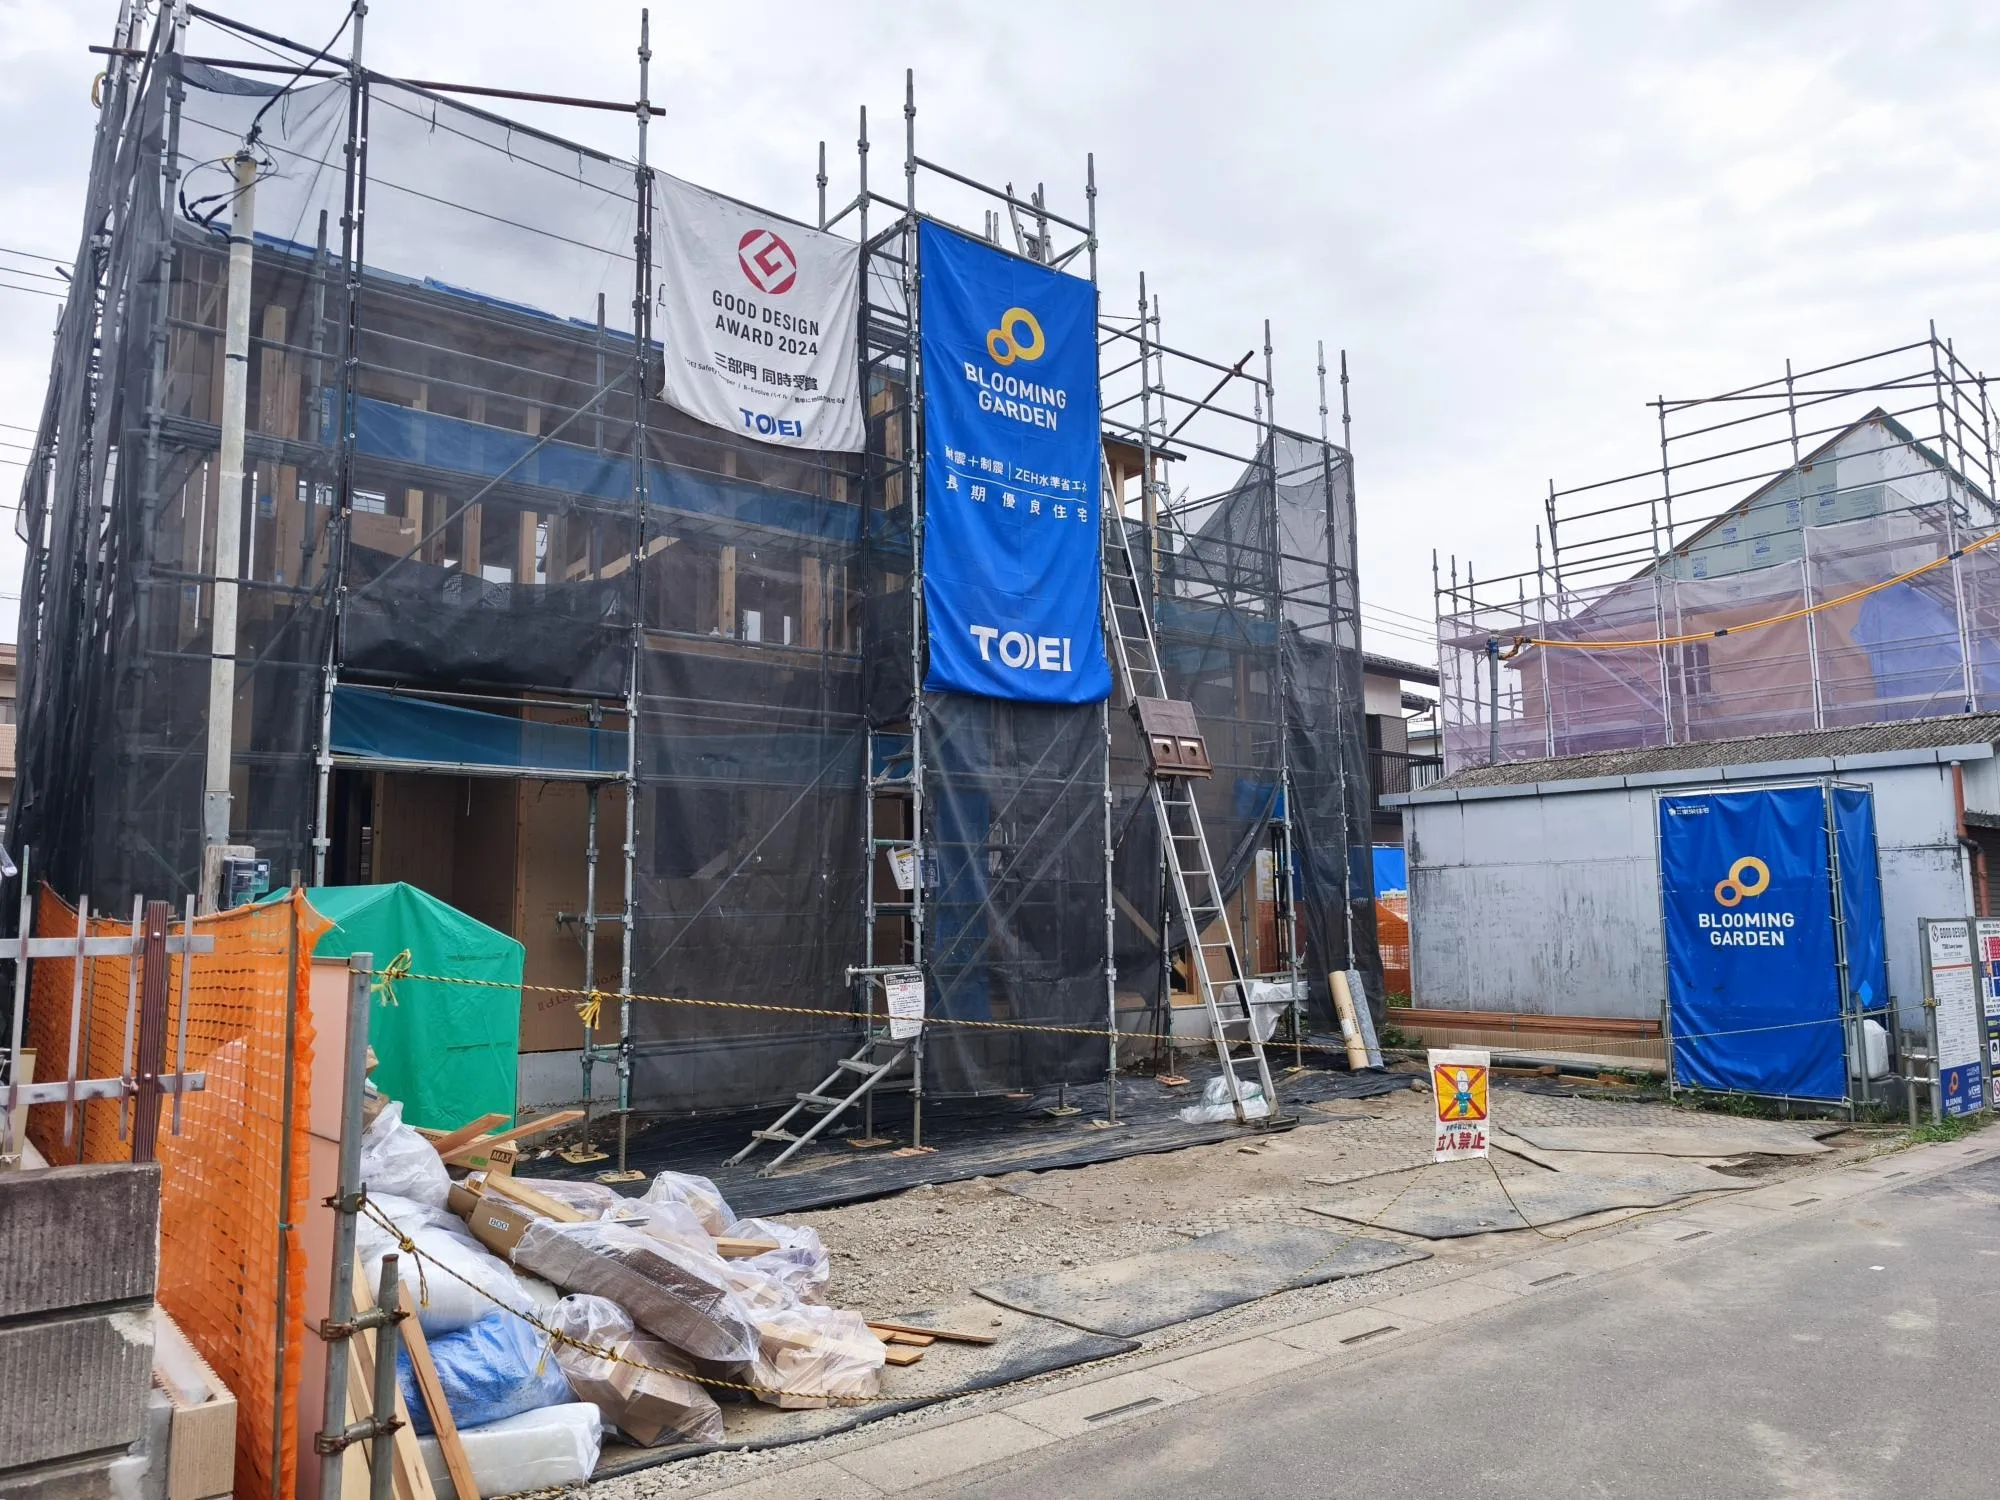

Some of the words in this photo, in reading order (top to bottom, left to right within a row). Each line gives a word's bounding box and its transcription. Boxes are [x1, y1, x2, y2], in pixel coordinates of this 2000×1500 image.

[712, 289, 757, 320] GOOD
[762, 308, 820, 337] DESIGN
[715, 314, 773, 347] AWARD
[778, 335, 819, 356] 2024
[714, 351, 757, 380] 三部門
[762, 368, 819, 391] 同時受賞
[963, 362, 1067, 409] BLOOMING
[739, 407, 802, 438] TOEI
[978, 390, 1057, 431] GARDEN
[970, 624, 1072, 672] TOEI
[1698, 912, 1795, 928] BLOOMING
[1710, 930, 1785, 946] GARDEN
[491, 1150, 512, 1164] MAX
[1436, 1131, 1486, 1151] 立入禁止
